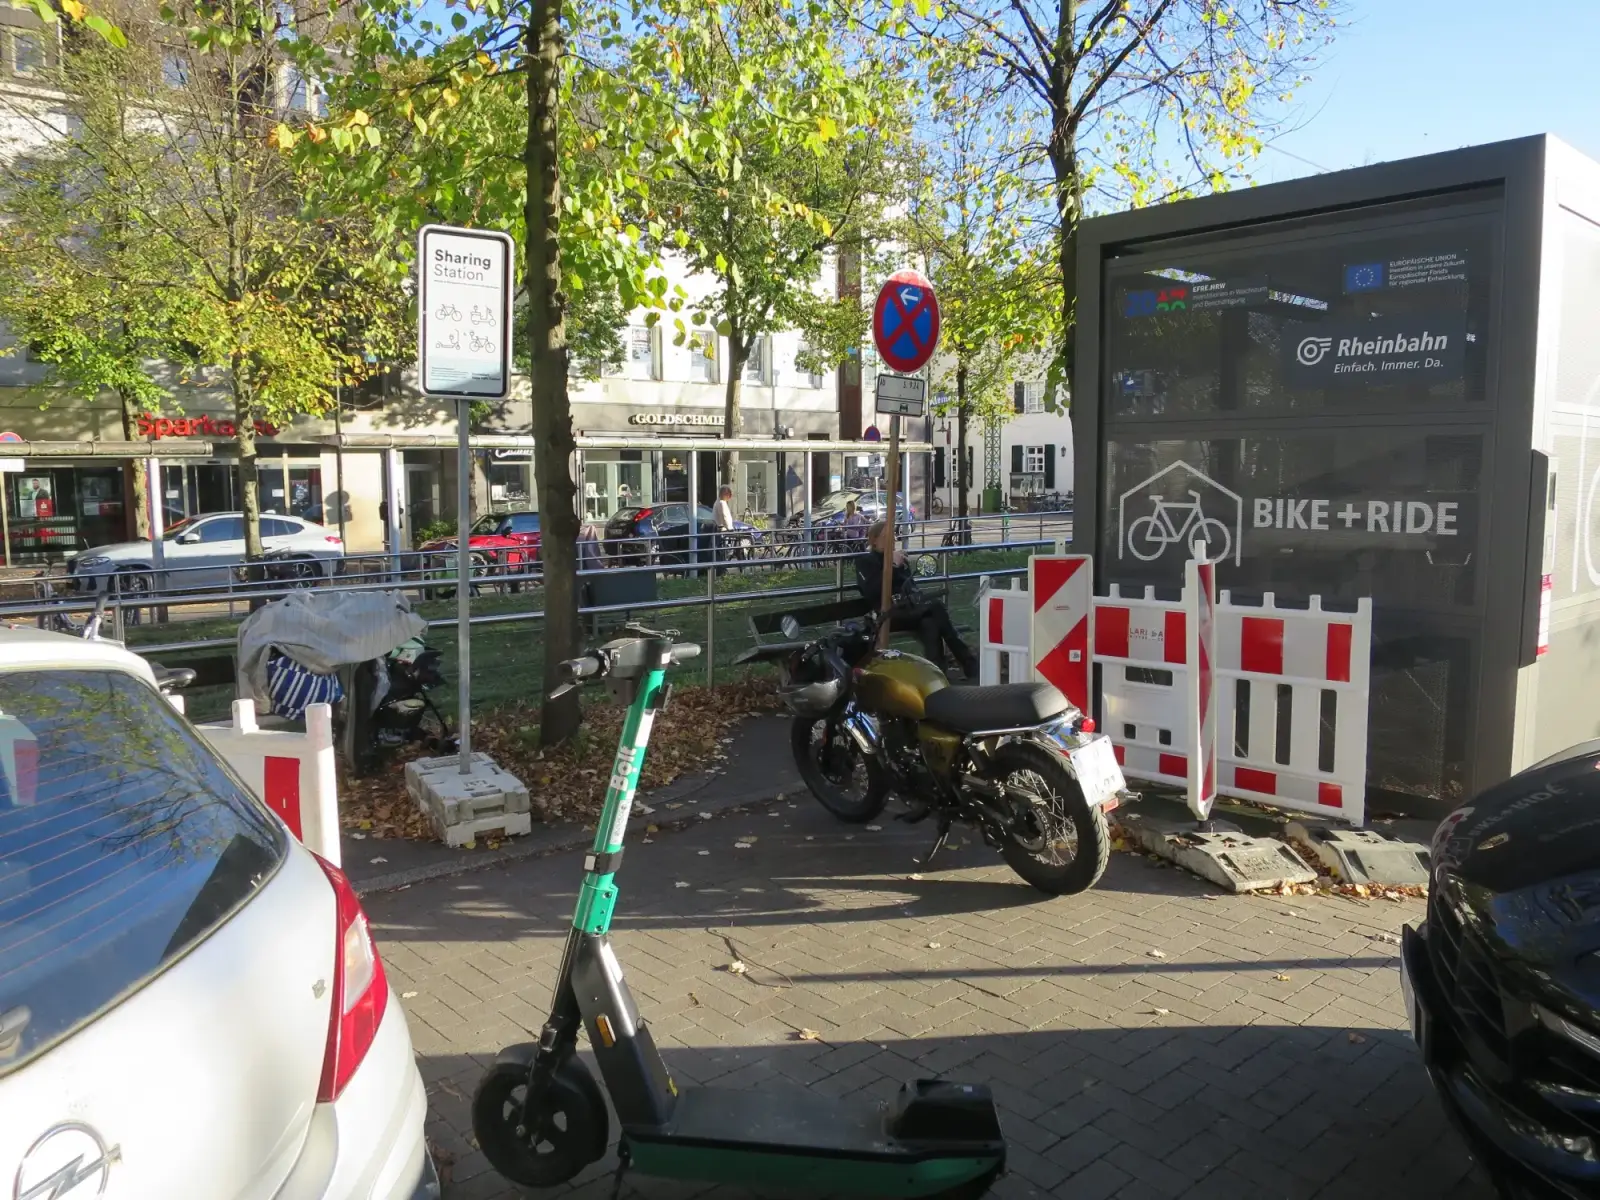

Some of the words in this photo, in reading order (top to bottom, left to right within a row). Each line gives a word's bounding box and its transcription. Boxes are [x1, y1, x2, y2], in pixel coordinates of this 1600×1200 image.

[435, 249, 491, 270] Sharing
[1389, 256, 1434, 267] EUROPÄISCHE
[1435, 254, 1457, 262] UNION
[434, 264, 484, 281] Station
[1337, 331, 1448, 357] Rheinbahn
[1334, 362, 1377, 374] Einfach.
[1381, 360, 1420, 370] Immer.
[1425, 357, 1444, 368] Da.
[137, 411, 281, 440] Sparkase
[610, 746, 637, 792] Bolt
